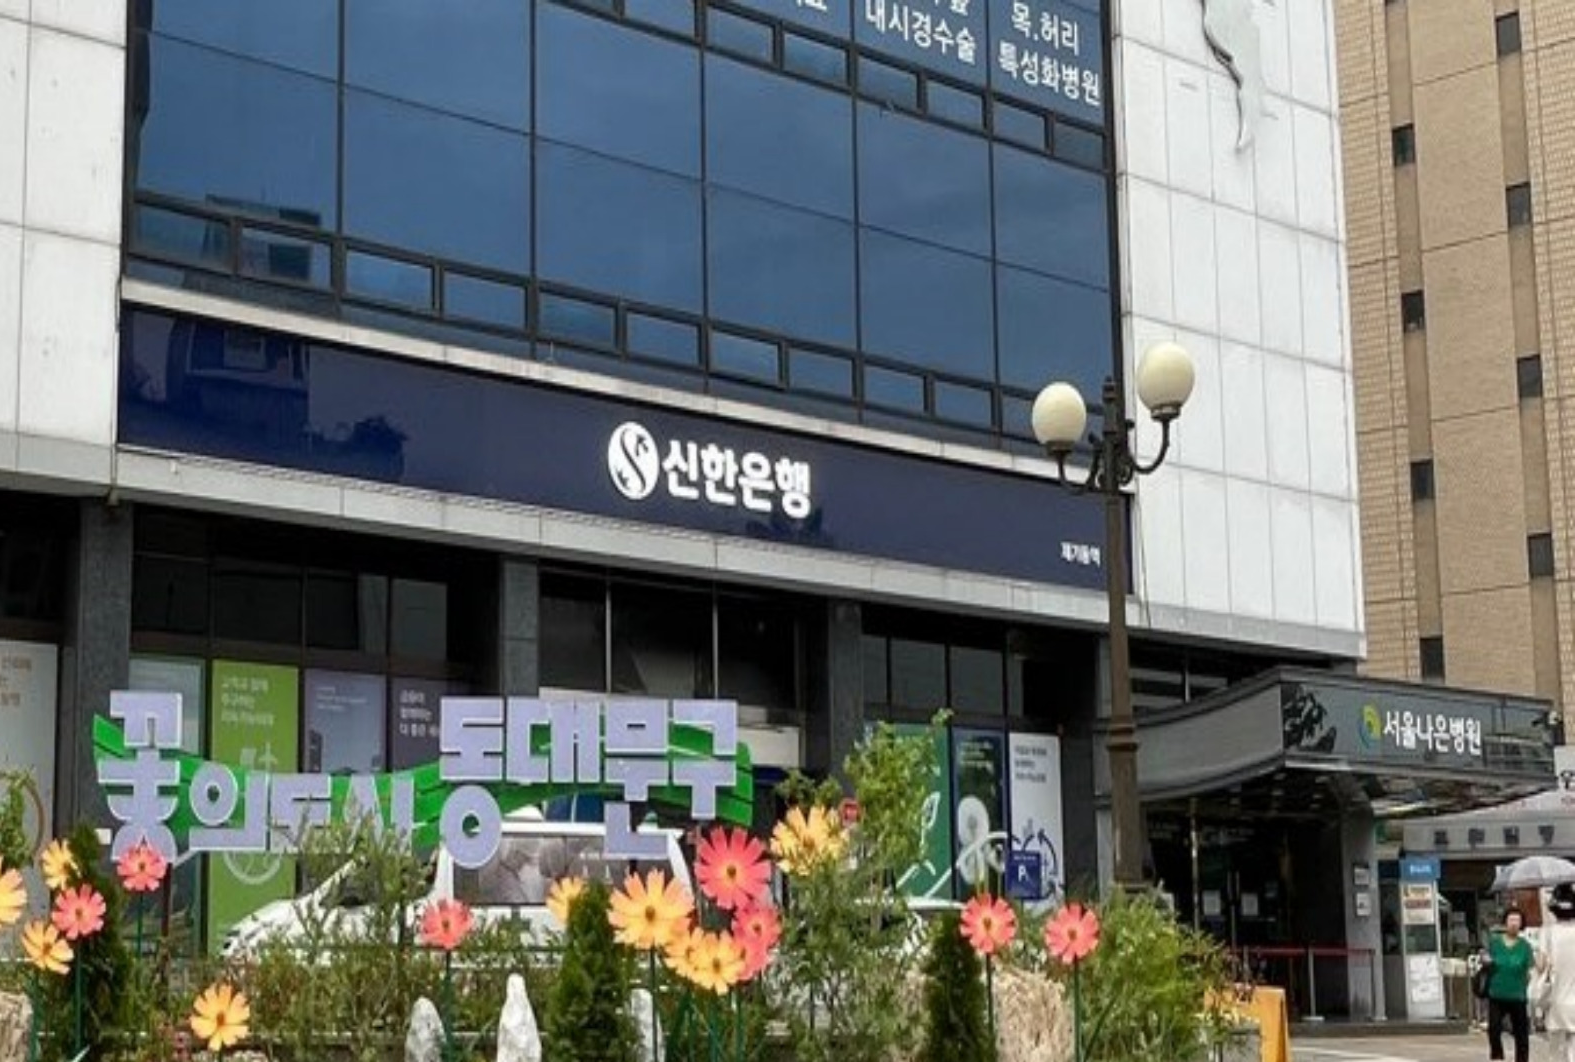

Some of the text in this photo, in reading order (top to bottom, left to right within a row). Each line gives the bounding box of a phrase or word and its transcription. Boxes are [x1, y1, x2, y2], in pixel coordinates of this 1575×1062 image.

[864, 0, 976, 65] 내시경수술
[1011, 1, 1080, 55] 목.허리
[998, 40, 1100, 107] 특성화병원
[662, 439, 811, 519] 신한은행
[1383, 711, 1483, 757] 서울나은병원
[440, 697, 738, 868] 동대문구
